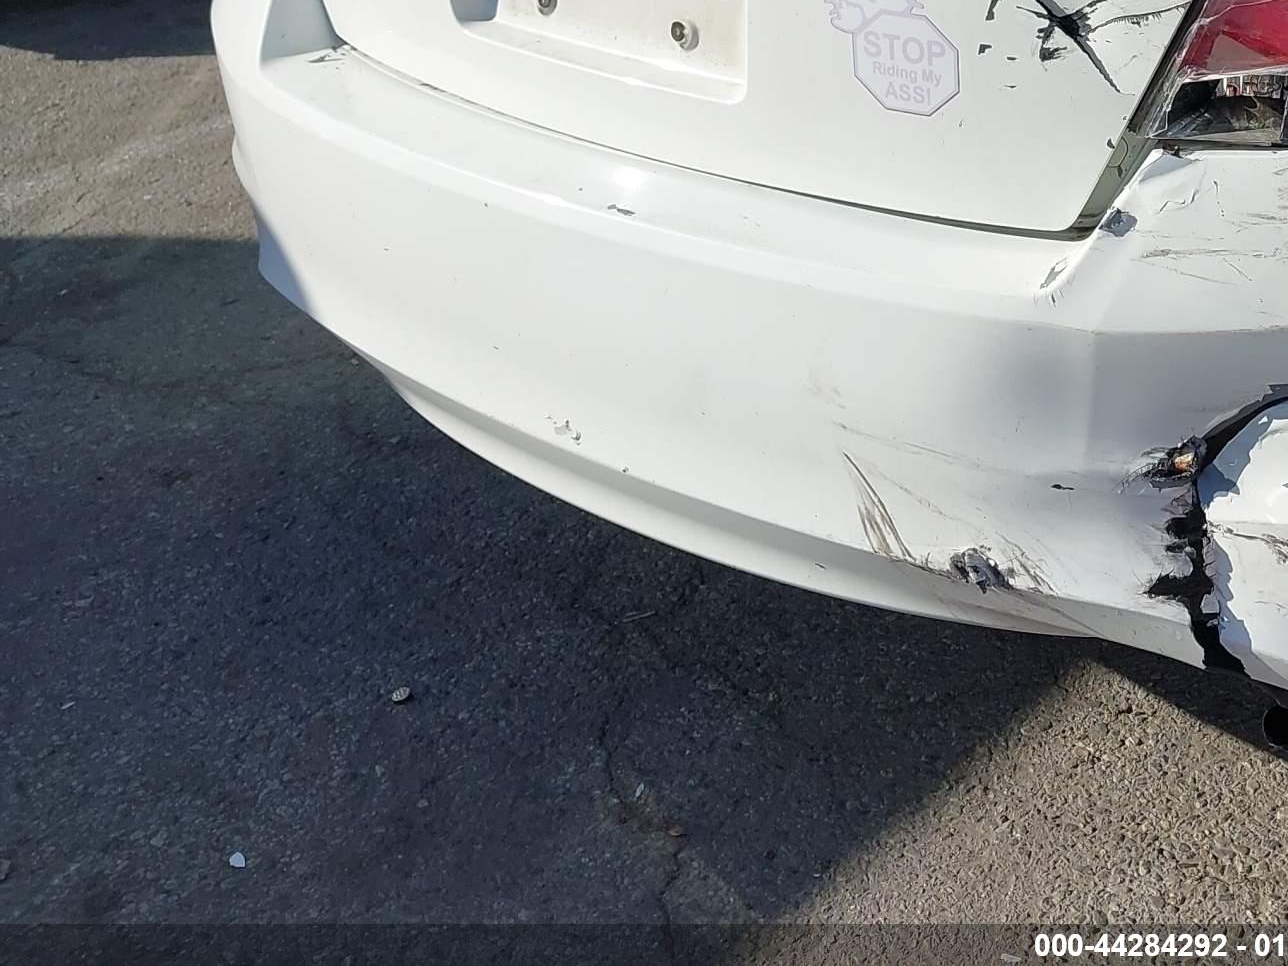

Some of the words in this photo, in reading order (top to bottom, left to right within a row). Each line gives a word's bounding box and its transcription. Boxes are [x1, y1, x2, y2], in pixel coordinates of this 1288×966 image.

[863, 30, 946, 67] STOP
[872, 61, 918, 84] Riding
[922, 68, 942, 88] My
